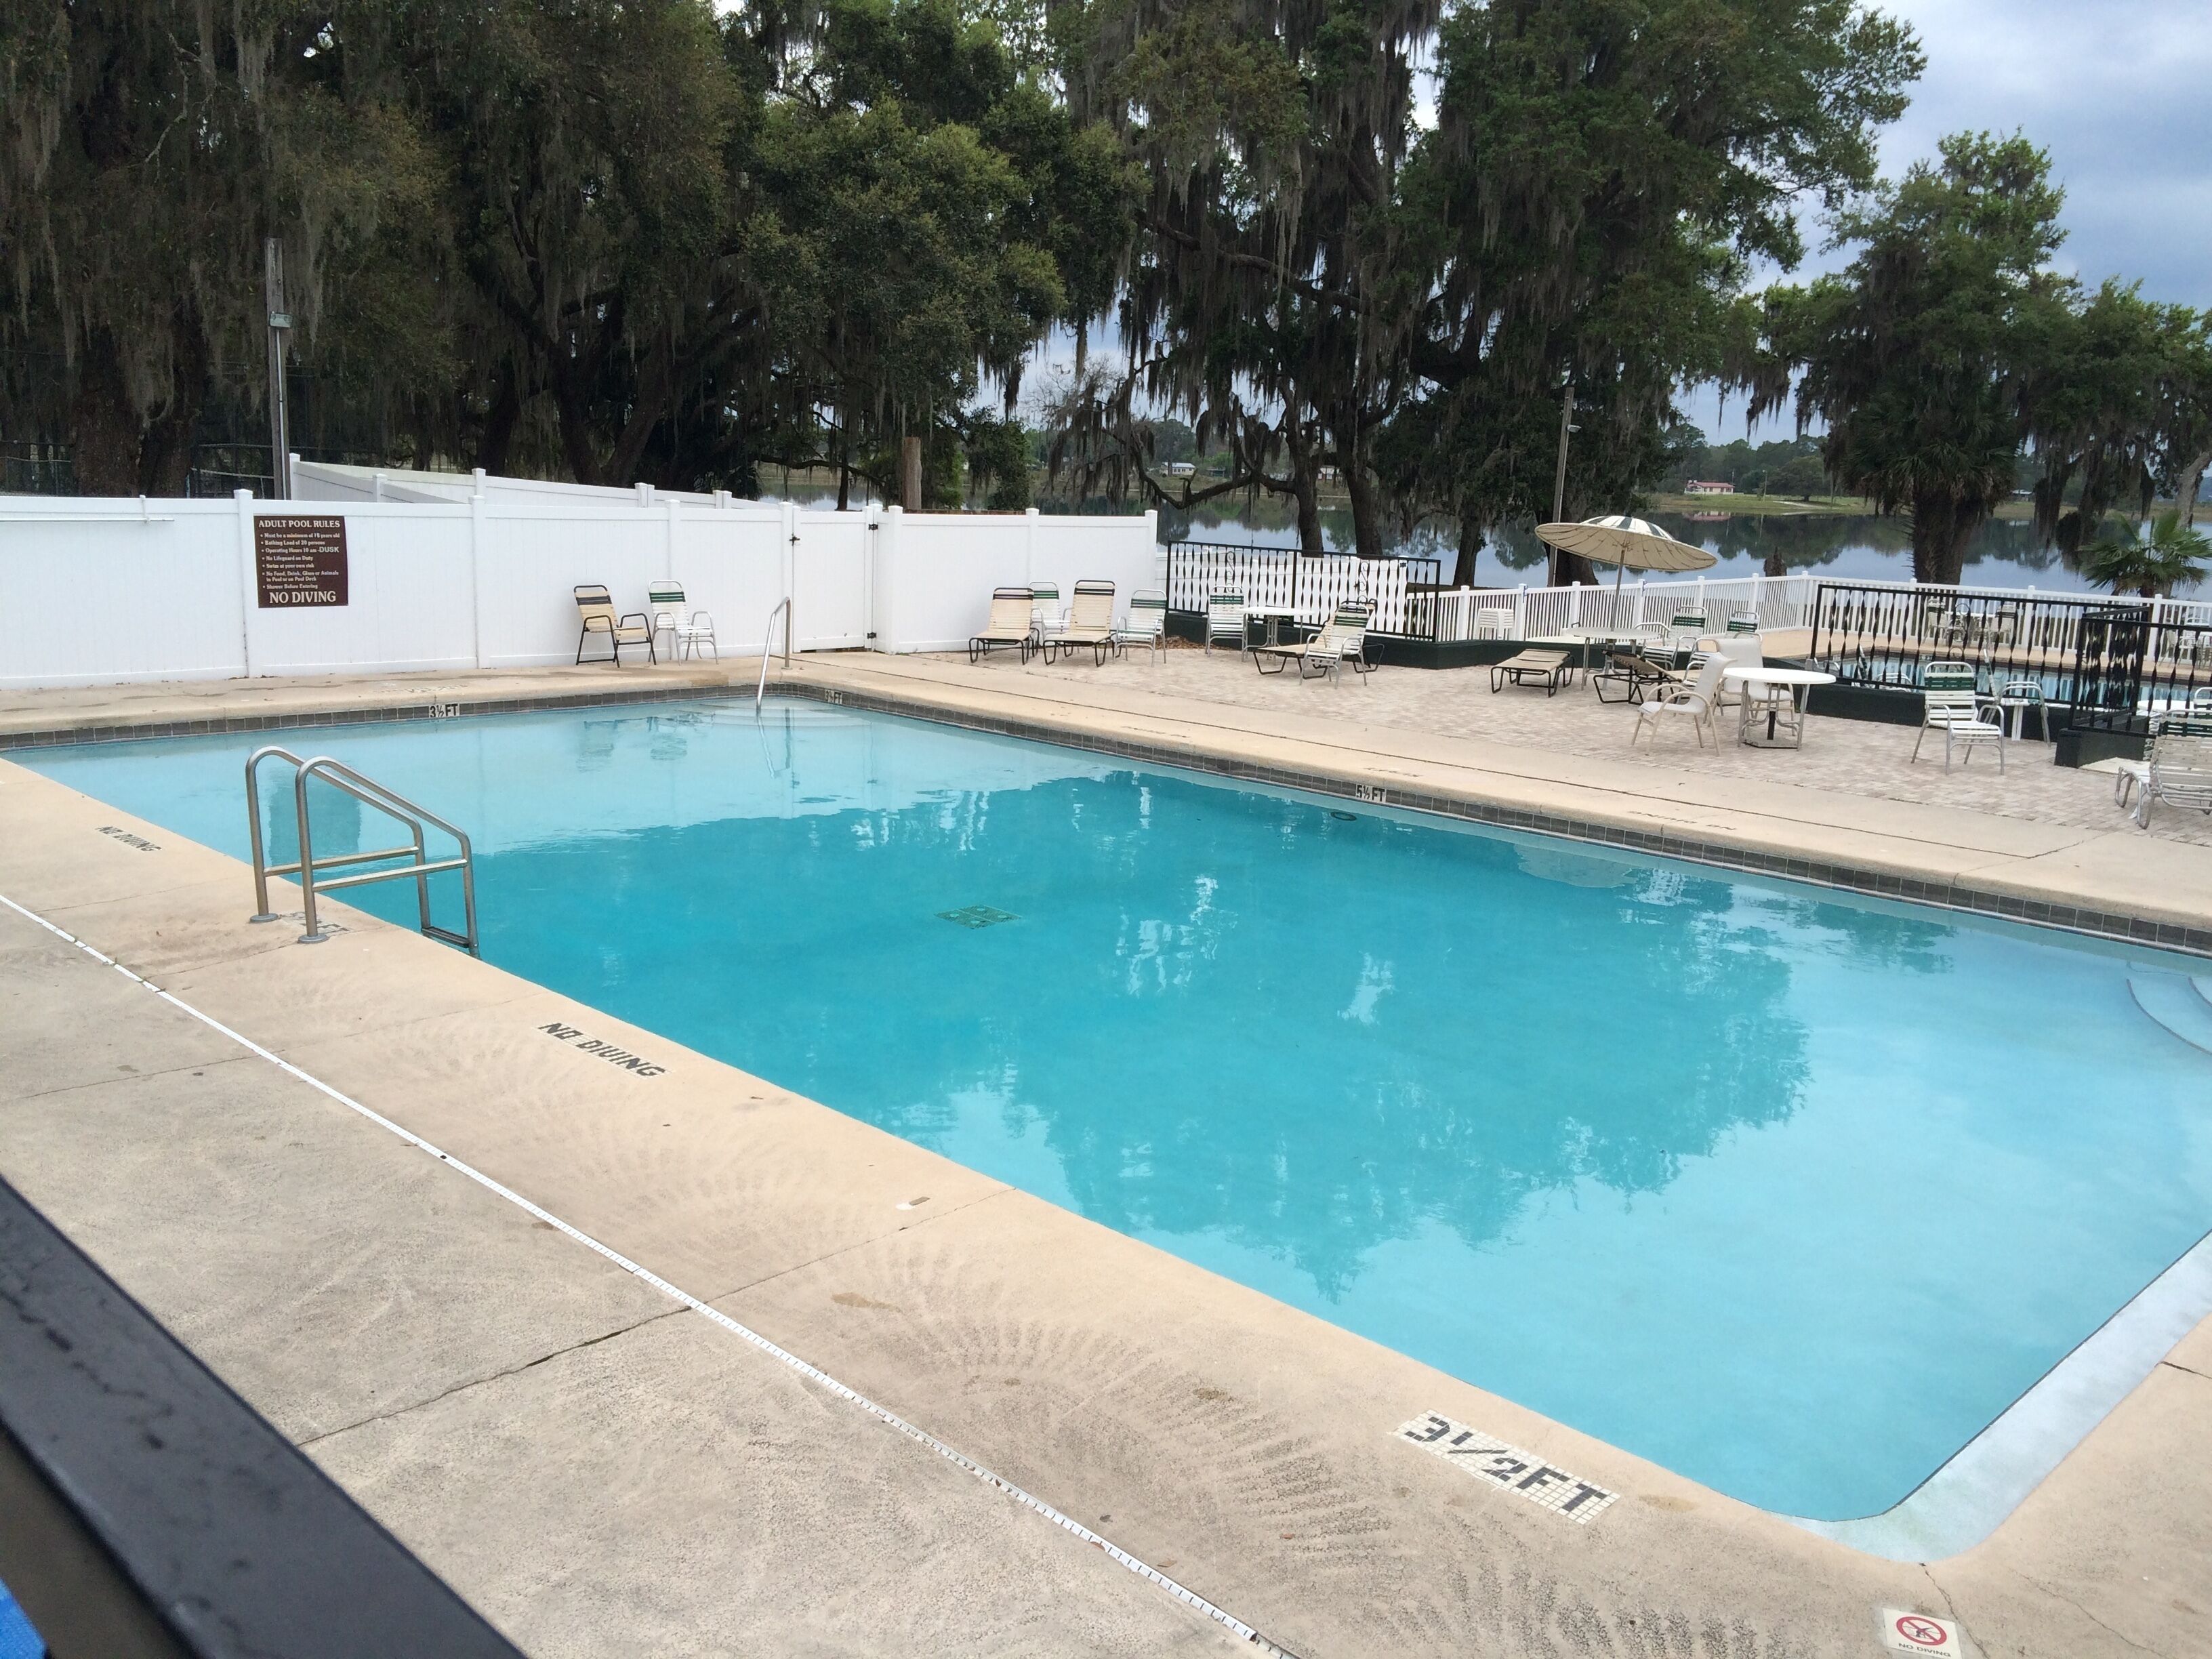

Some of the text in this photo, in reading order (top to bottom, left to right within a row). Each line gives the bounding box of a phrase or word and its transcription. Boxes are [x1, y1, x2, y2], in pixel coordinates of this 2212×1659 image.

[269, 590, 337, 604] NO DIVING
[537, 1023, 583, 1040] NO
[1917, 1647, 1951, 1658] DIVING
